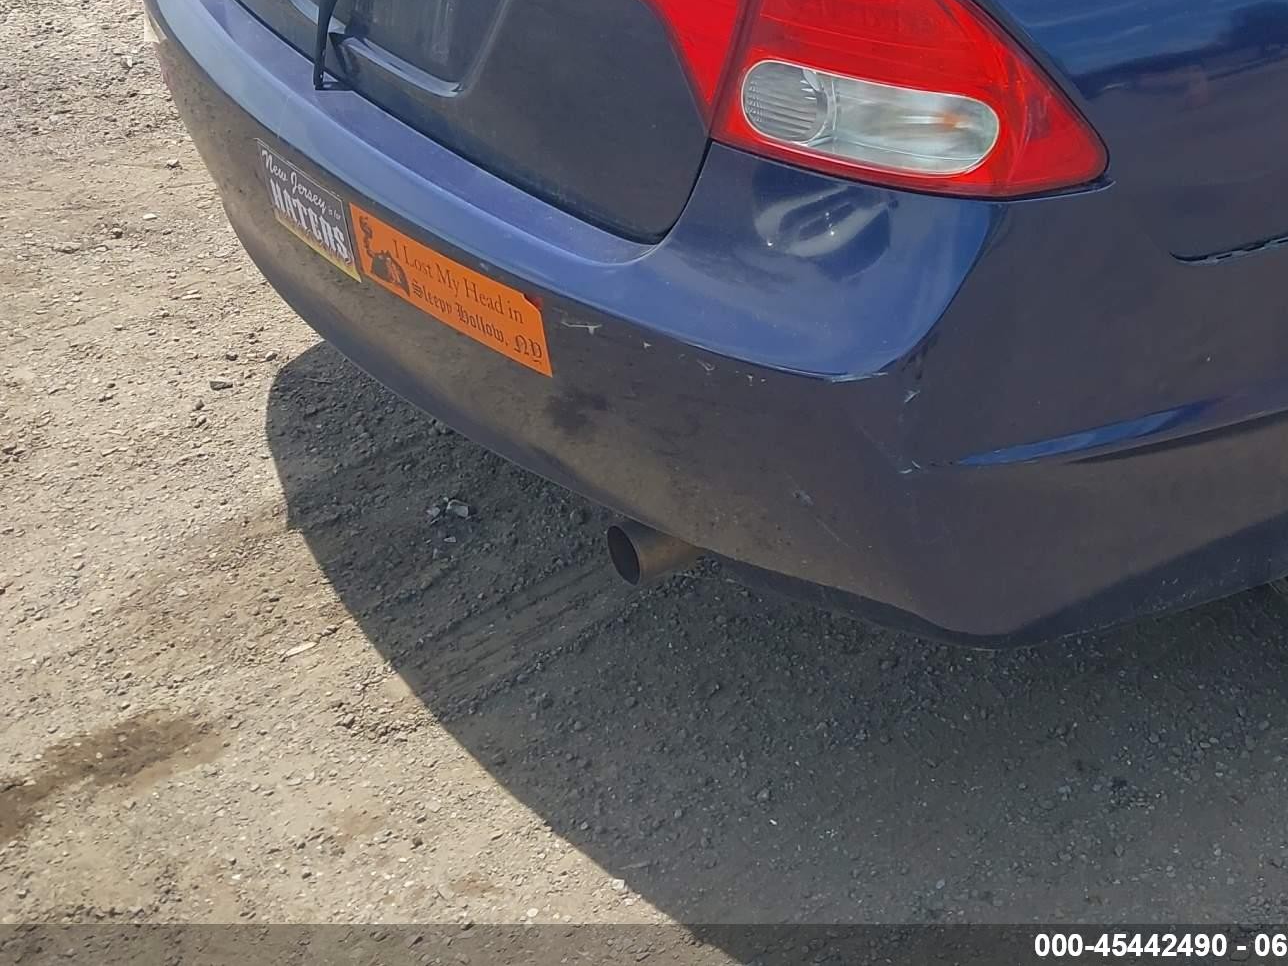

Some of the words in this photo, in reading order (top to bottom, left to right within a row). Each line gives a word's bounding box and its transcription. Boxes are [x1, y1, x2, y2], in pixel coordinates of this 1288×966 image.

[262, 150, 288, 181] New
[290, 172, 327, 214] Jersey
[270, 177, 349, 259] HATERS
[392, 238, 401, 259] I
[403, 245, 432, 278] Lost
[436, 262, 461, 297] My
[462, 277, 504, 315] Head
[506, 299, 524, 324] in
[411, 278, 453, 315] Sleepy
[514, 334, 543, 363] NY
